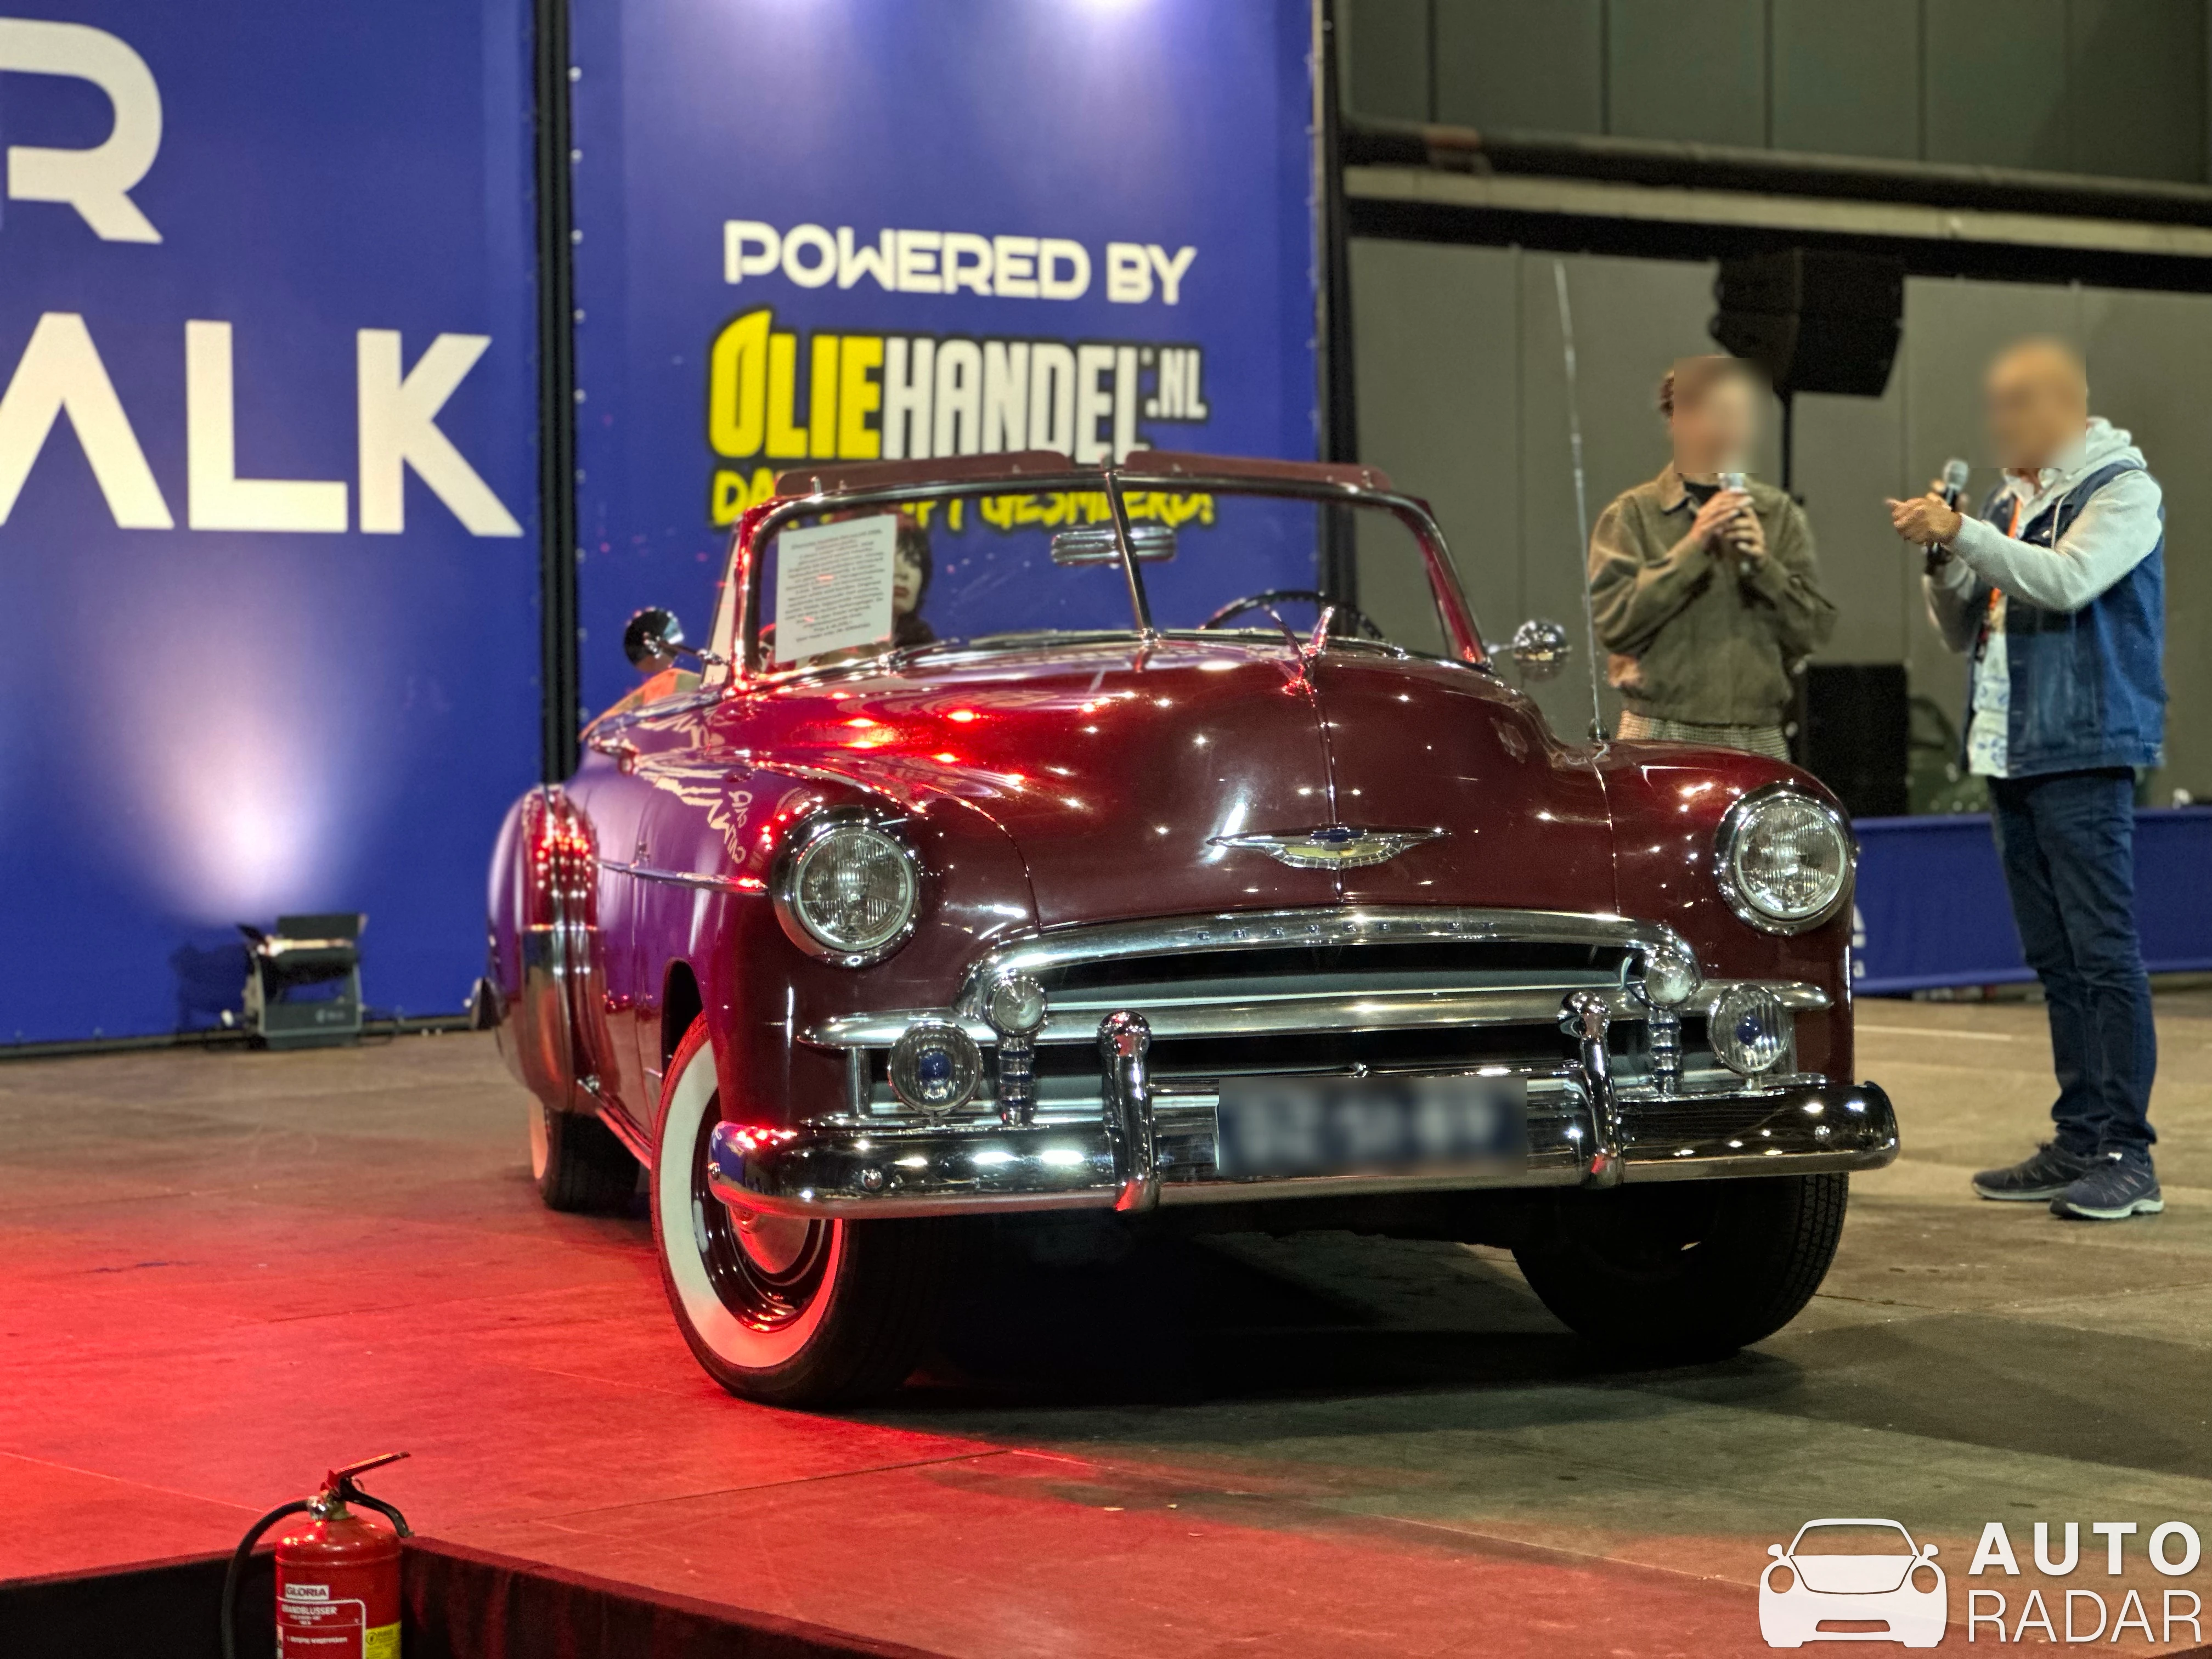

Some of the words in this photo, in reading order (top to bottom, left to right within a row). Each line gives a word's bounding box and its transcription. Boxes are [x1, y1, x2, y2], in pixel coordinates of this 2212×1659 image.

[724, 220, 1092, 301] POWERED
[1106, 242, 1198, 305] BY
[712, 467, 799, 530] DA
[286, 1586, 327, 1596] GLORIA
